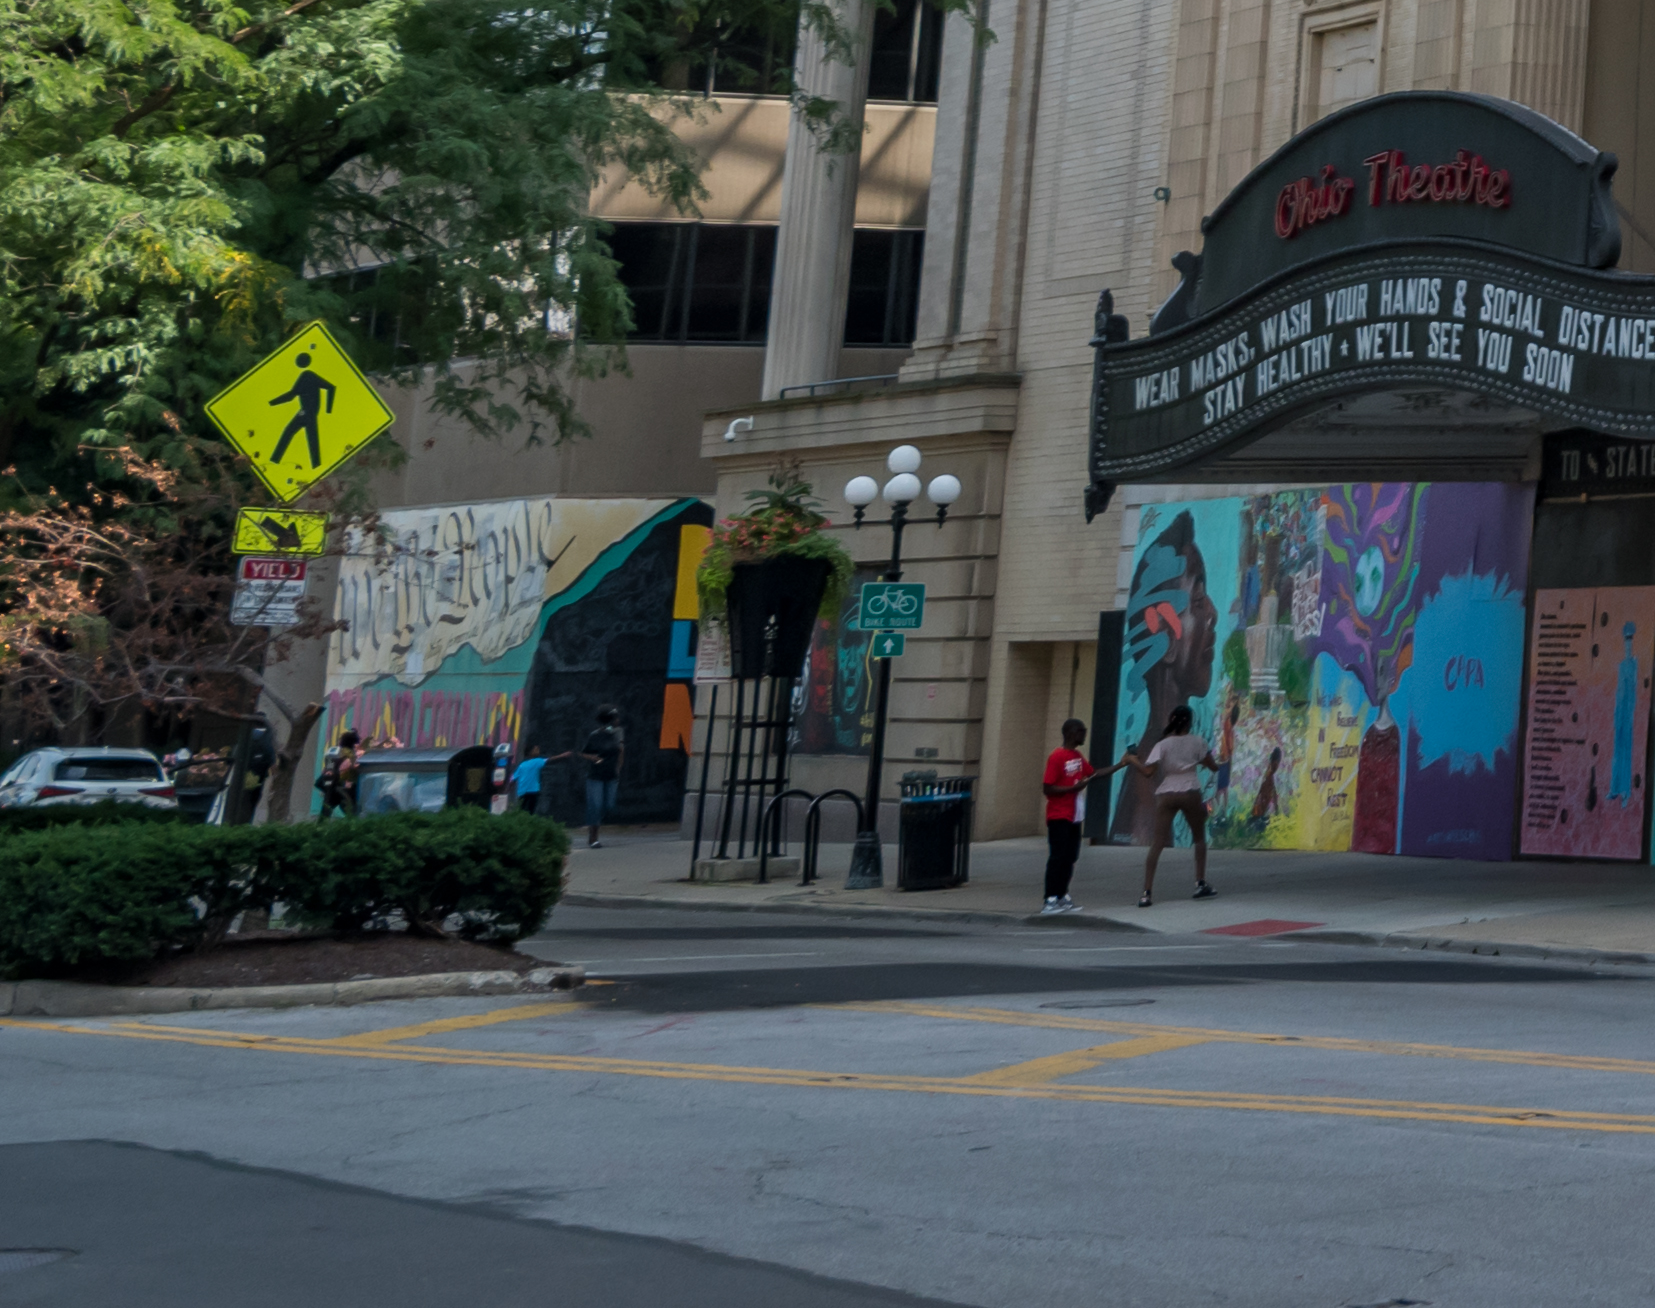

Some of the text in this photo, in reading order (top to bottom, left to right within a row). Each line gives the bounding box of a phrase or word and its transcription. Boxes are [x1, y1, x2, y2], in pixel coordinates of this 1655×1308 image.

[1274, 147, 1512, 240] Ohio Theatre
[1135, 366, 1180, 410] WEAR
[1190, 331, 1256, 392] MASKS,
[1261, 299, 1312, 352] WASH
[1325, 284, 1368, 326] YOUR
[1380, 278, 1441, 316] HANDS
[1453, 280, 1467, 318] &
[1480, 284, 1544, 338] SOCIAL
[1203, 321, 1574, 426] STAY HEALTHY WE'LL SEE YOU SOON
[1562, 450, 1580, 481] TO
[864, 617, 917, 627] BIKE ROUTE
